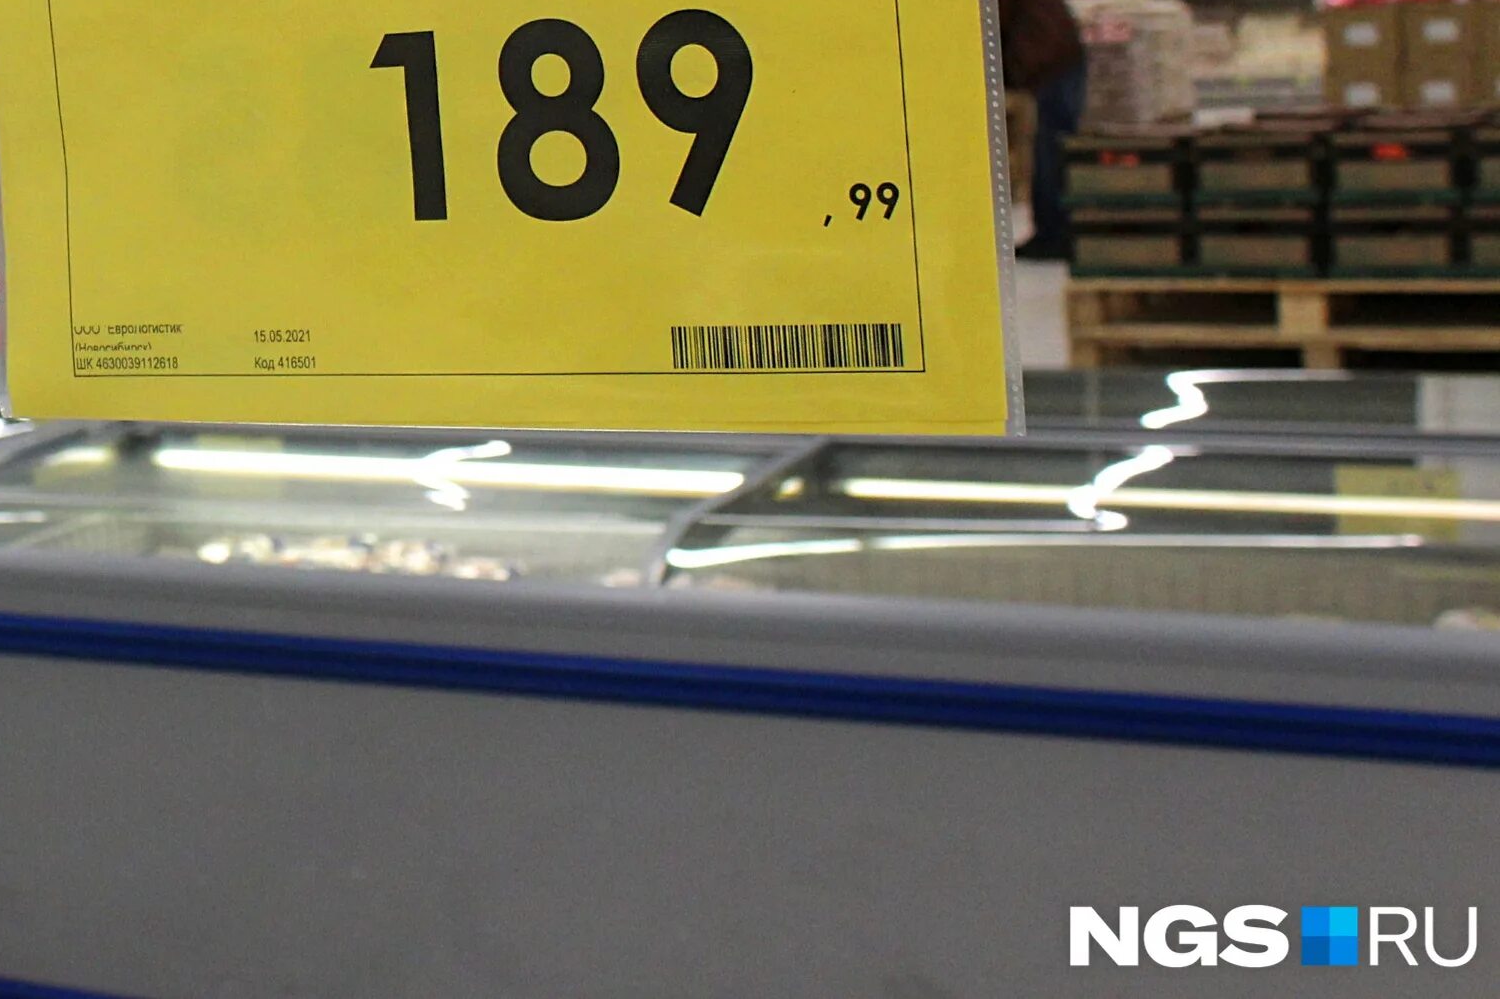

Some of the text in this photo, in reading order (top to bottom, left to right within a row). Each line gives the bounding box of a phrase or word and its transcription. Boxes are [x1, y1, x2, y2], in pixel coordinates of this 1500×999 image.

[369, 8, 754, 222] 189
[254, 329, 311, 343] 15.05.2021
[76, 356, 179, 370] ШК 4630039112618
[254, 356, 317, 370] Код 416501
